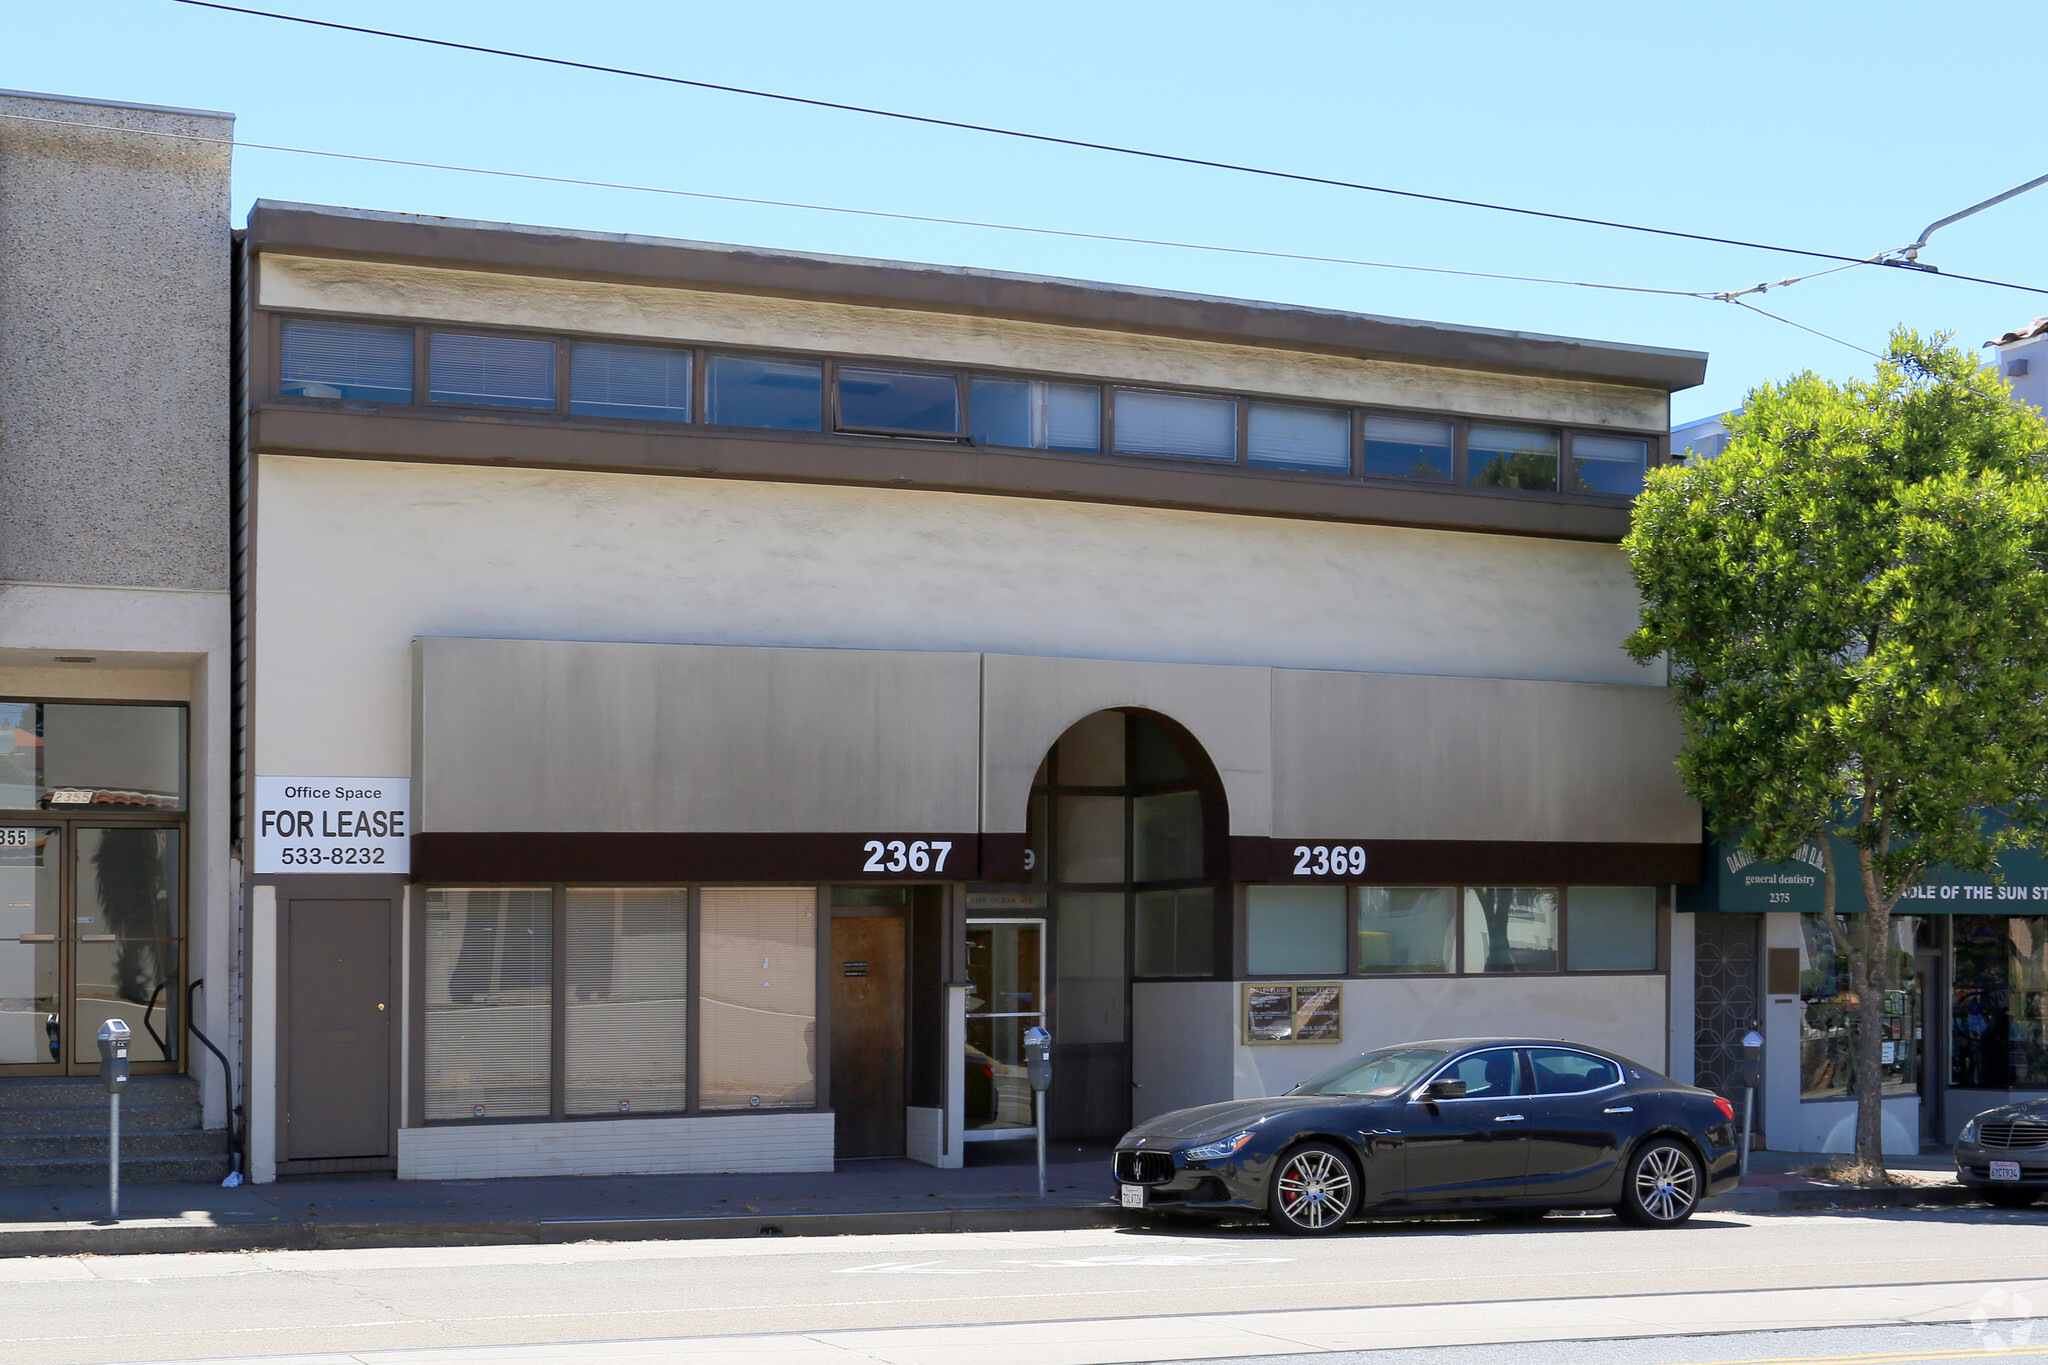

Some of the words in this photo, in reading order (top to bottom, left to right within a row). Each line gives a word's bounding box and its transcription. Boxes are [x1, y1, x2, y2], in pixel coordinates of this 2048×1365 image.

[55, 793, 91, 802] 2355
[285, 786, 331, 799] Office
[335, 786, 382, 801] Space
[261, 810, 314, 837] FOR
[322, 810, 405, 837] LEASE
[281, 847, 385, 865] 533-8232
[863, 840, 952, 872] 2367
[1293, 845, 1366, 875] 2369
[1745, 874, 1777, 886] general
[1779, 874, 1815, 886] dentistry
[1769, 893, 1790, 903] 2375
[1940, 885, 1960, 899] OF
[1964, 886, 1993, 899] THE
[1997, 886, 2027, 900] SUN
